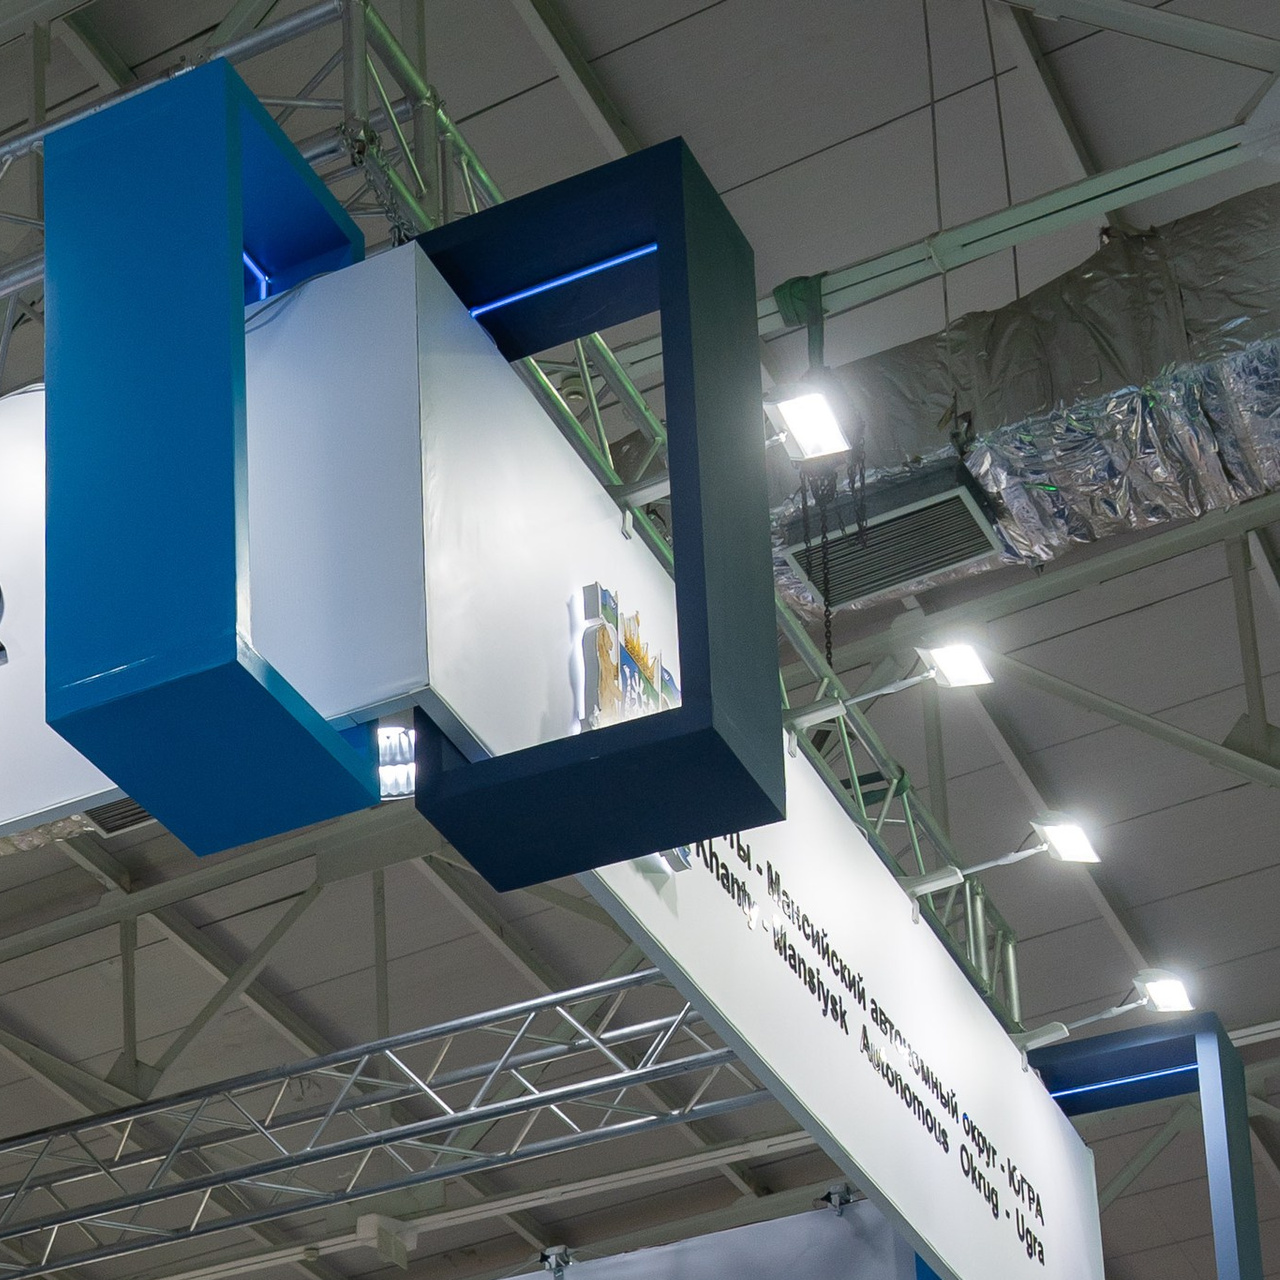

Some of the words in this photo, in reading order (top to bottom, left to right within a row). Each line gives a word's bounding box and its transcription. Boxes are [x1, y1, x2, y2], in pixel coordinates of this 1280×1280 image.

[767, 860, 866, 1011] Мансийский
[870, 998, 959, 1123] автономный
[962, 1112, 997, 1168] округ
[1007, 1157, 1045, 1226] ЮГРА
[773, 920, 849, 1036] Mansiysk
[860, 1024, 949, 1154] Autonomous
[960, 1143, 999, 1220] Okrug
[1016, 1207, 1045, 1266] Ugra
